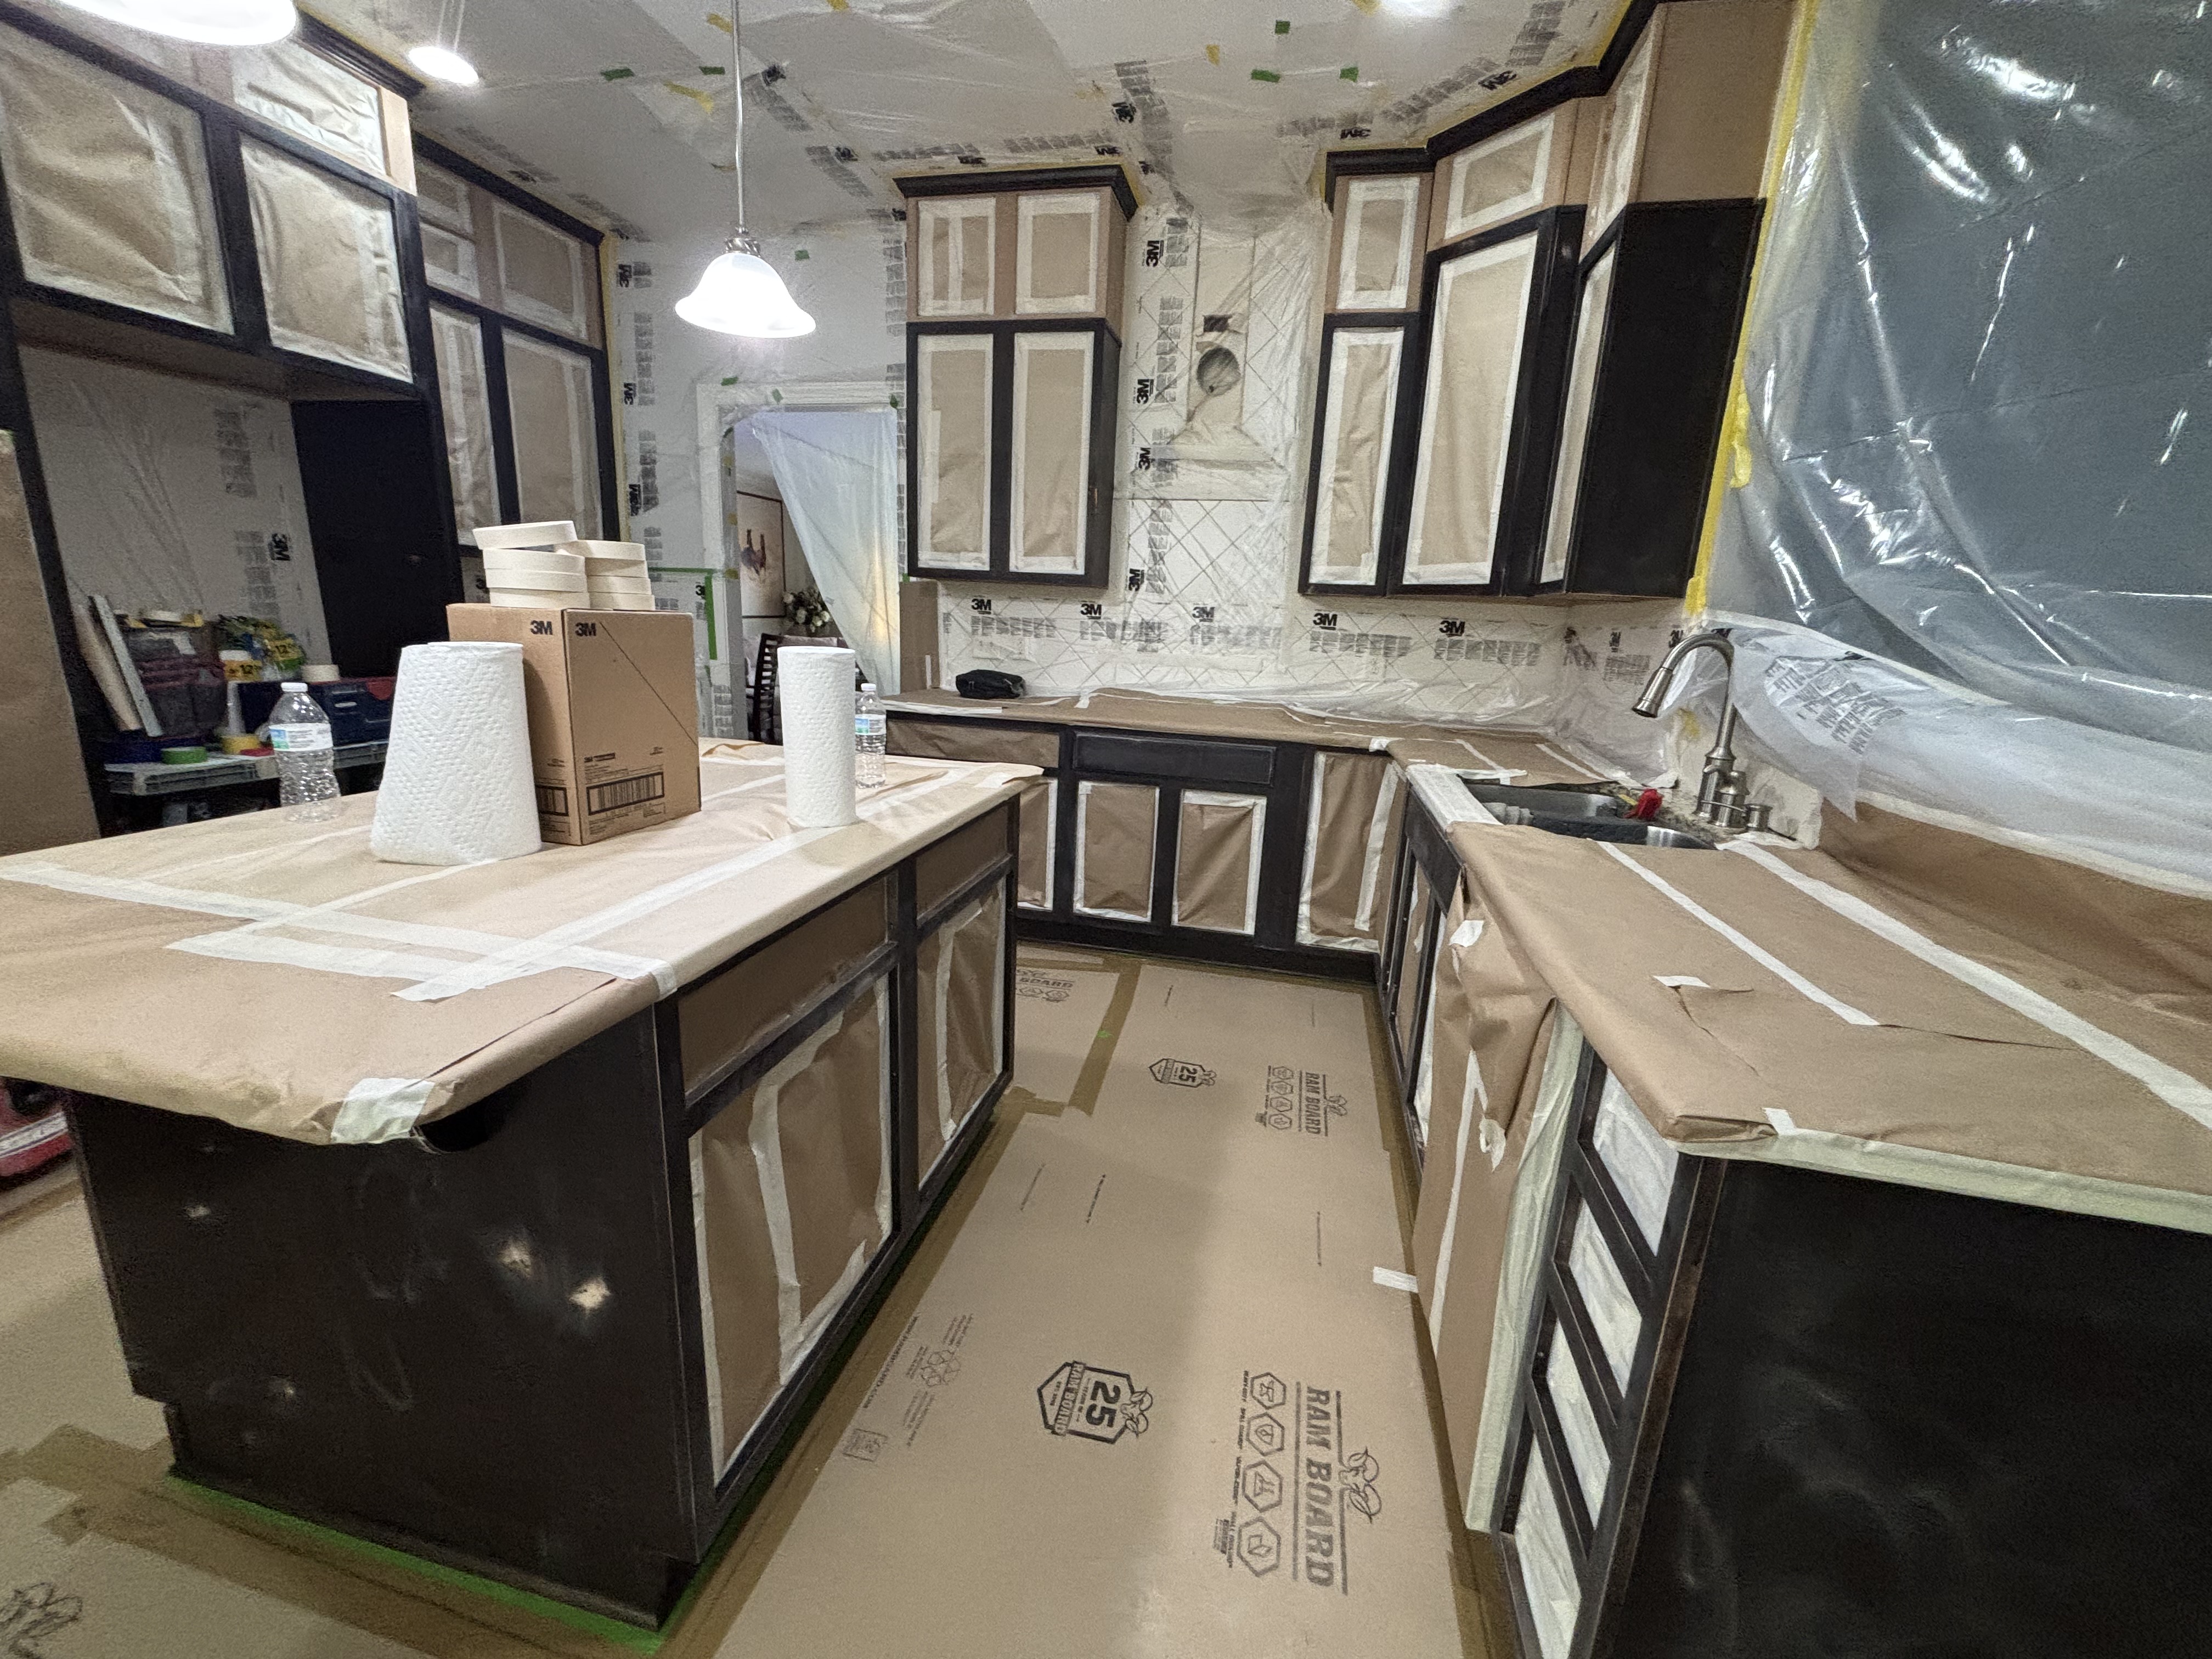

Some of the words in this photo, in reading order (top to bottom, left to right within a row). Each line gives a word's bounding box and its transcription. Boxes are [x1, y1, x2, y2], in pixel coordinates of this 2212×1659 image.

[1146, 240, 1159, 267] 3M
[1137, 379, 1149, 404] 3M
[1138, 447, 1150, 470] 3M
[1128, 568, 1141, 591] 3M
[972, 599, 991, 611] 3M
[1081, 603, 1102, 616] 3M
[1192, 607, 1214, 619] 3M
[531, 620, 552, 635] 3M
[1313, 613, 1338, 626] 3M
[1439, 620, 1465, 634] 3M
[575, 623, 597, 636] 3M
[1179, 1066, 1197, 1082] 25
[1086, 1381, 1120, 1427] 25
[1306, 1386, 1331, 1451] RAM
[1305, 1457, 1334, 1587] BOARD
